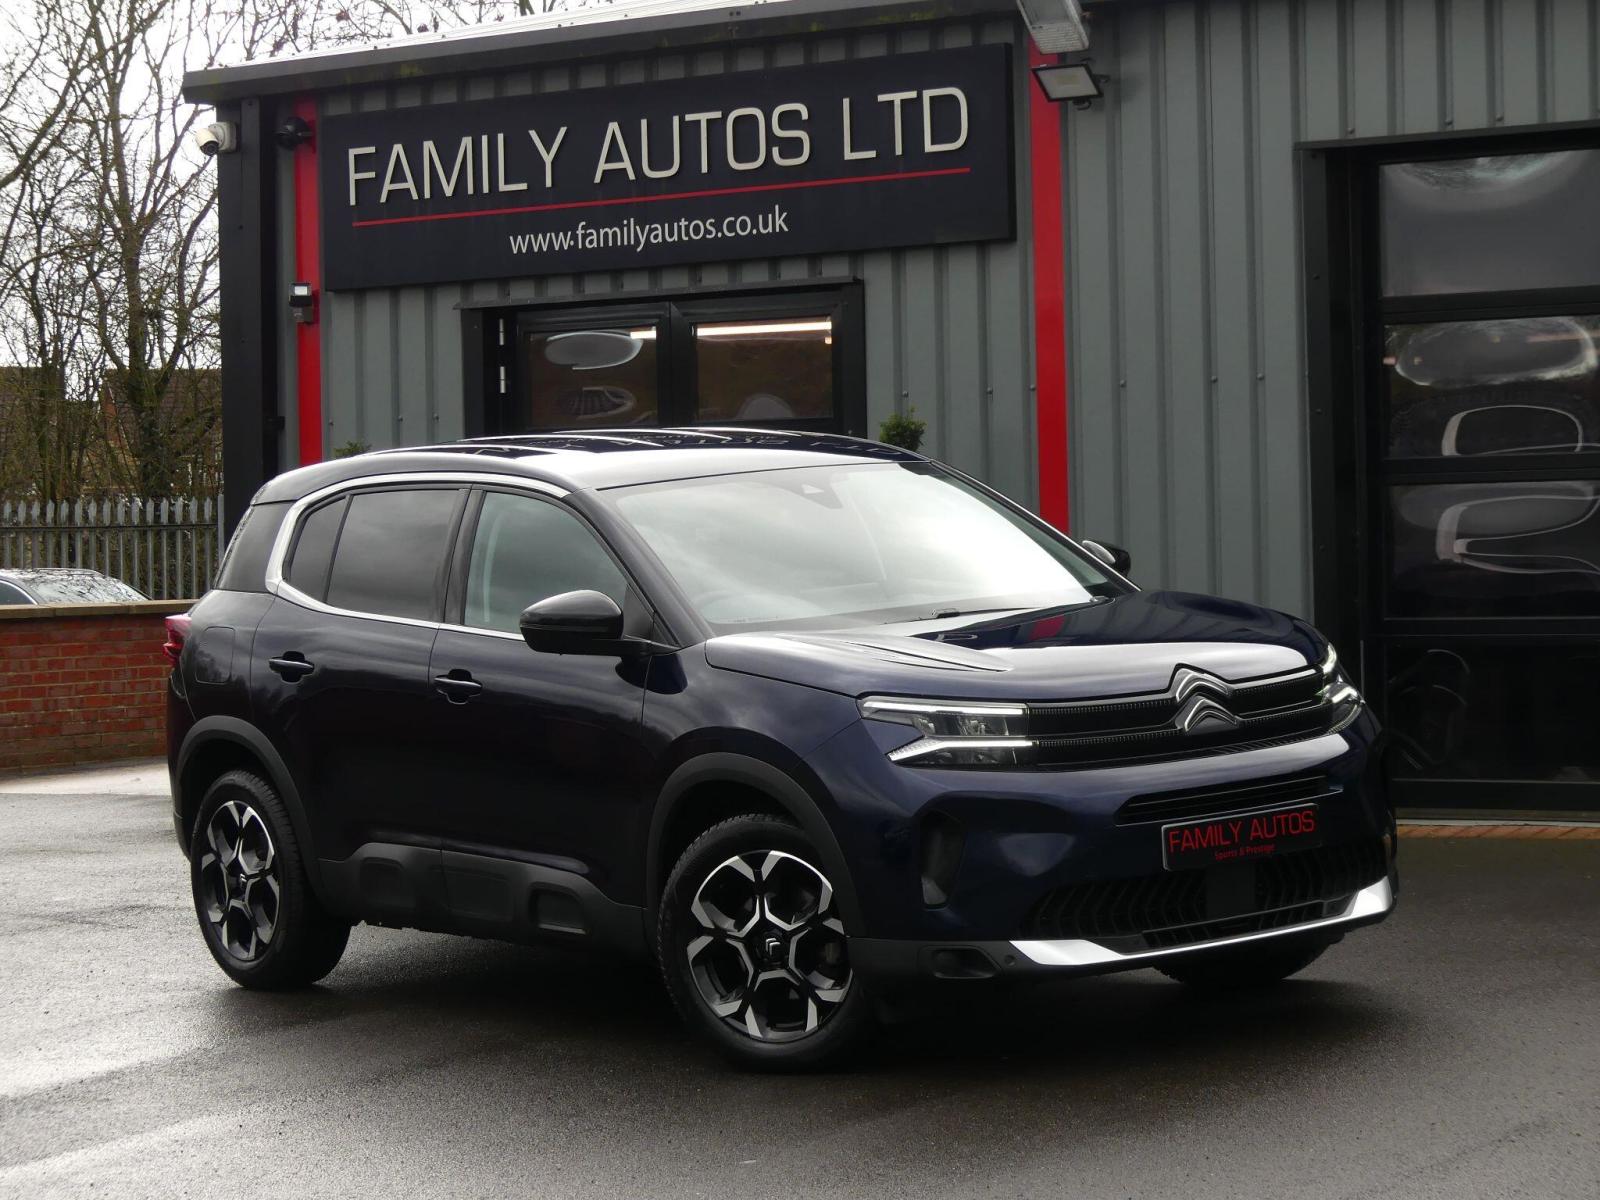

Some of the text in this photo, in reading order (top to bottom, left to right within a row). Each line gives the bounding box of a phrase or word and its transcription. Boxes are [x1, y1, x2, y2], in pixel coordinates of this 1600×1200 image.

[347, 86, 969, 207] FAMILY AUTOS LTD
[508, 204, 789, 255] www.familyautos.co.uk
[1168, 810, 1315, 854] FAMILY AUTOS
